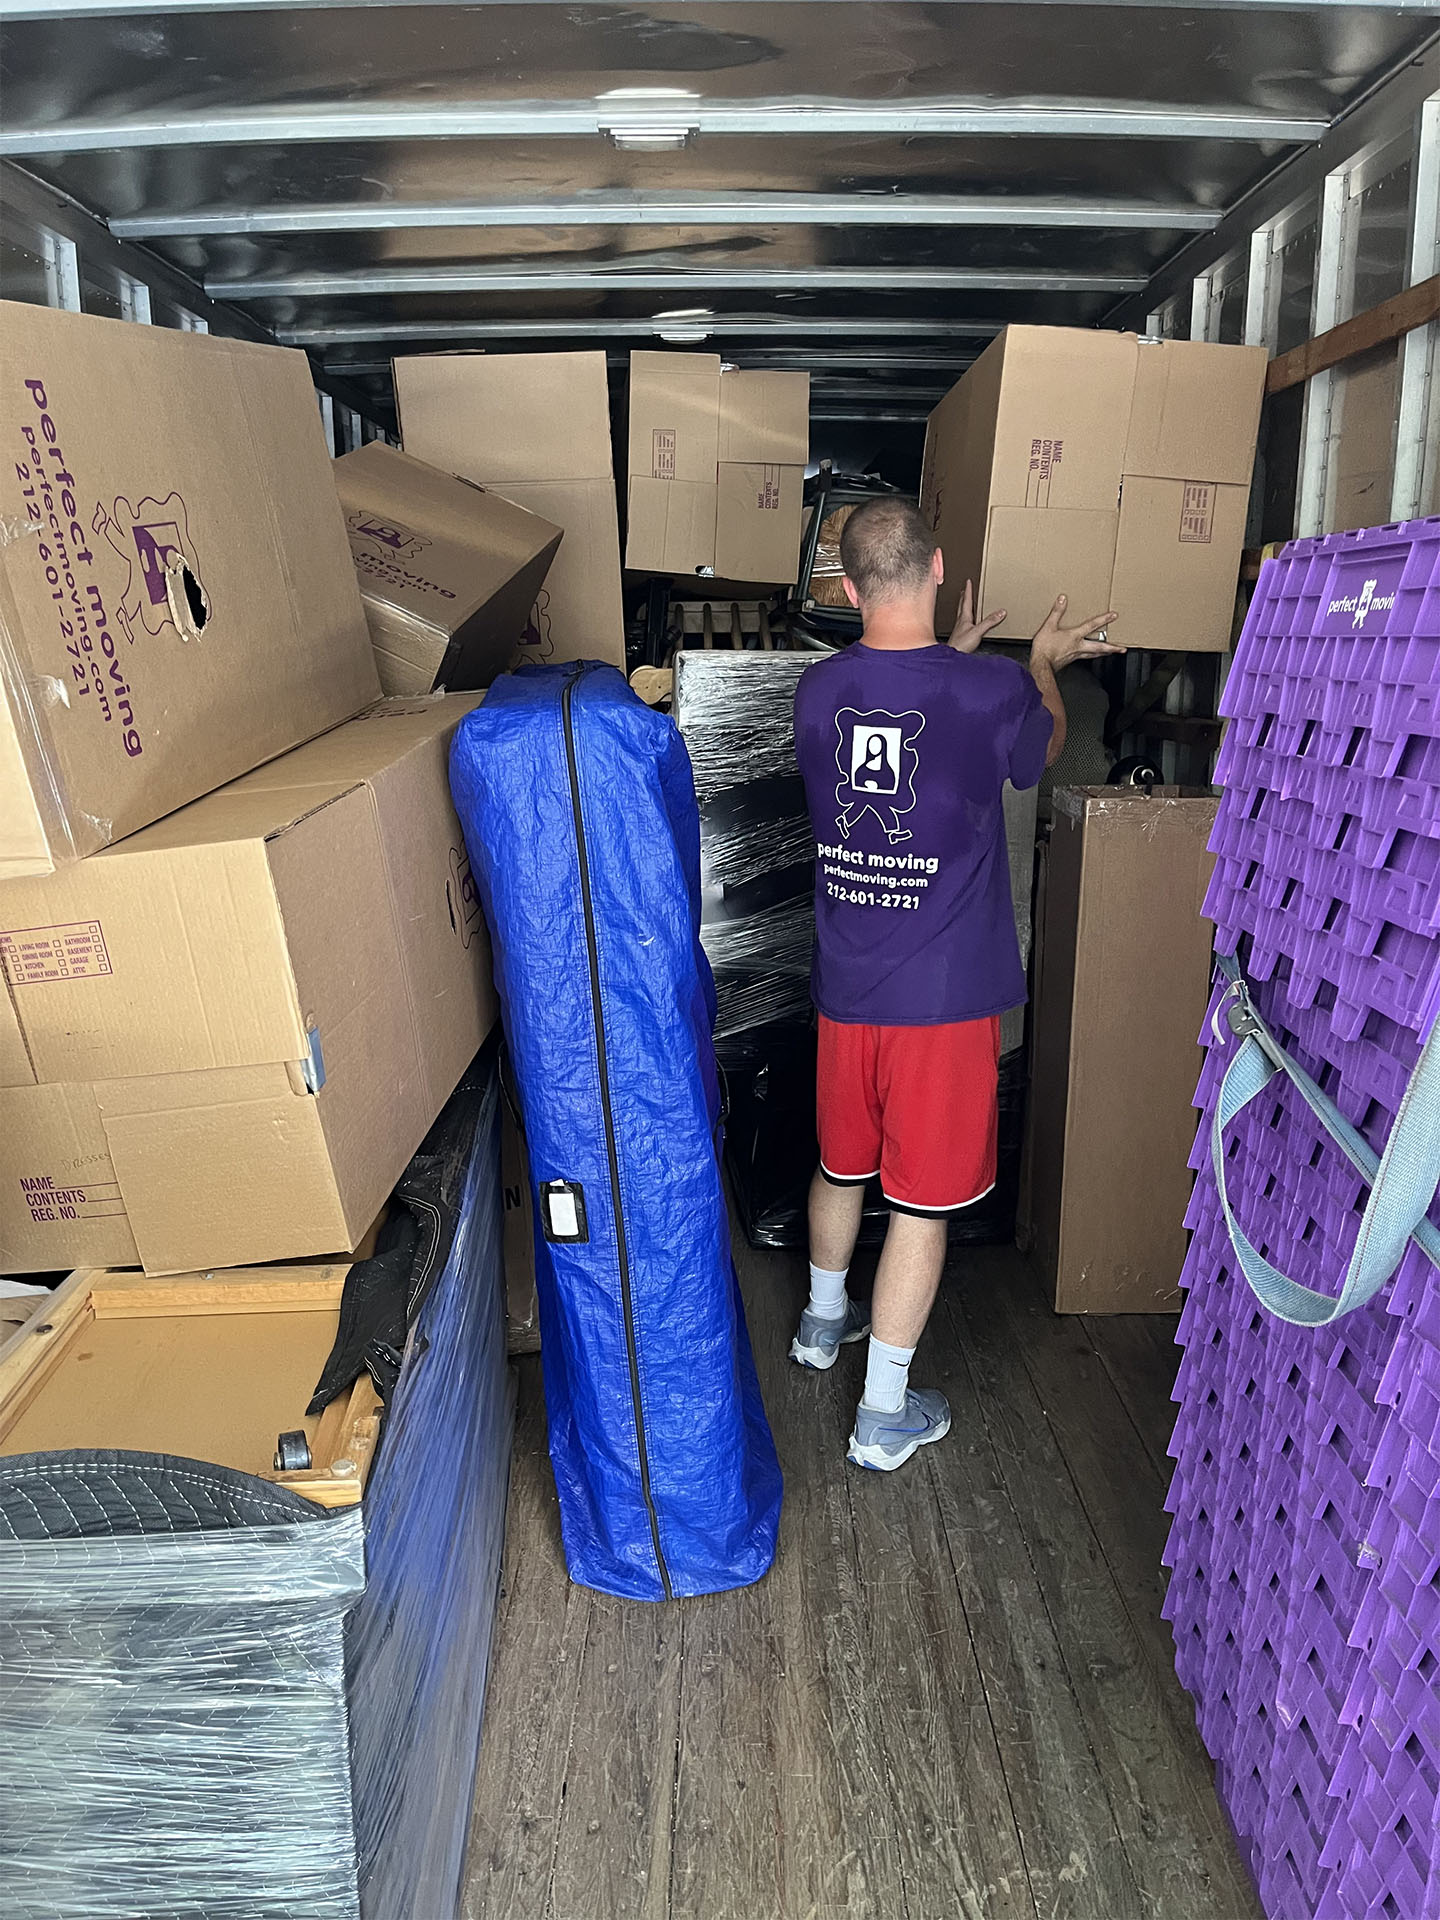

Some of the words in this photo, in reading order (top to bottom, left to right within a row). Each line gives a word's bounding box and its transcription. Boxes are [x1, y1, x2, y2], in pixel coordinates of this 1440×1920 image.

[1031, 440, 1041, 456] REG.
[1052, 441, 1063, 463] NAME
[1029, 458, 1040, 471] NO.
[1039, 440, 1052, 480] CONTENTS
[15, 463, 90, 695] 212-601-2721
[21, 426, 112, 722] perfectmoving.com
[24, 379, 93, 566] perfect
[86, 585, 143, 757] moving
[360, 552, 456, 599] moving
[1326, 595, 1358, 617] perfect
[817, 842, 864, 866] perfect
[868, 853, 939, 874] moving
[824, 863, 929, 889] perfectmoving.com
[826, 882, 920, 910] 212-601-2721
[35, 941, 50, 950] ROOM
[64, 936, 91, 946] BATHROOM
[39, 950, 53, 959] ROOM
[67, 945, 93, 956] BASEMENT
[24, 961, 45, 970] KITCHEN
[69, 956, 89, 965] GARAGE
[44, 969, 59, 978] ROOM
[72, 966, 86, 975] ATTIC
[20, 1176, 55, 1192] NAME
[25, 1189, 86, 1207] CONTENTS
[30, 1207, 58, 1222] REG.
[59, 1205, 80, 1220] NO.
